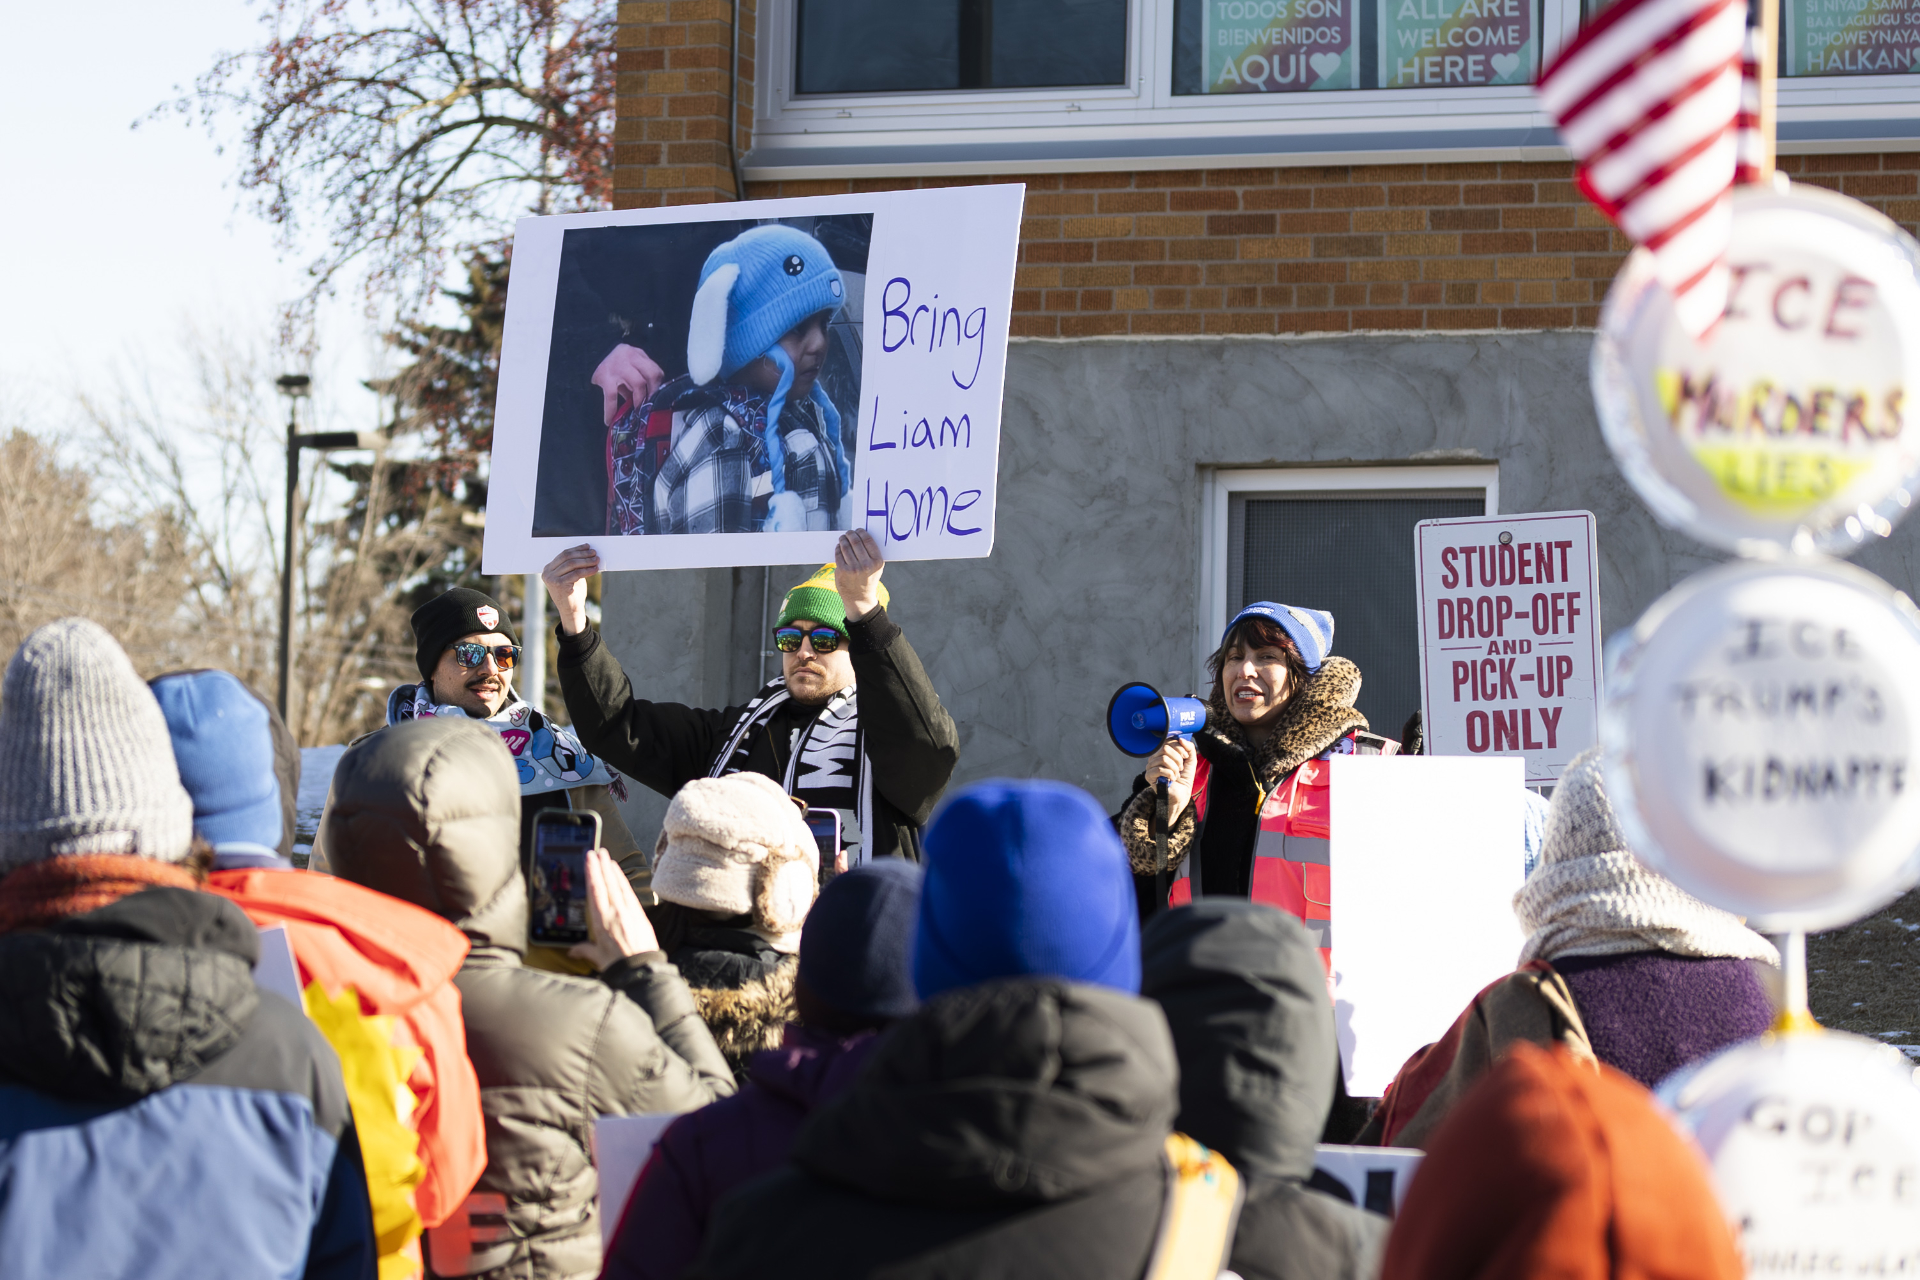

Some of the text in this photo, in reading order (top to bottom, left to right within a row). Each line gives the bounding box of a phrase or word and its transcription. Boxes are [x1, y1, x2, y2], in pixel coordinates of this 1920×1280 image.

[1217, 0, 1341, 20] TODOS SON
[1396, 0, 1520, 20] ALL ARE
[1806, 15, 1834, 28] BAA
[1838, 13, 1900, 27] LAGUUGU
[1824, 0, 1868, 12] NIYAD
[1218, 26, 1341, 46] BIENVENIDOS
[1397, 25, 1520, 48] WELCOME
[1217, 46, 1307, 91] AQUÍ
[1397, 54, 1486, 84] HERE
[1806, 47, 1911, 71] HALKAN
[1725, 260, 1878, 341] ICE
[882, 277, 987, 390] Bring
[869, 394, 971, 451] Liam
[865, 477, 983, 547] Home
[1441, 540, 1573, 590] STUDENT
[1437, 592, 1581, 640] DROP-OFF
[1487, 639, 1532, 656] AND
[1452, 655, 1574, 703] PICK-UP
[1466, 706, 1563, 753] ONLY
